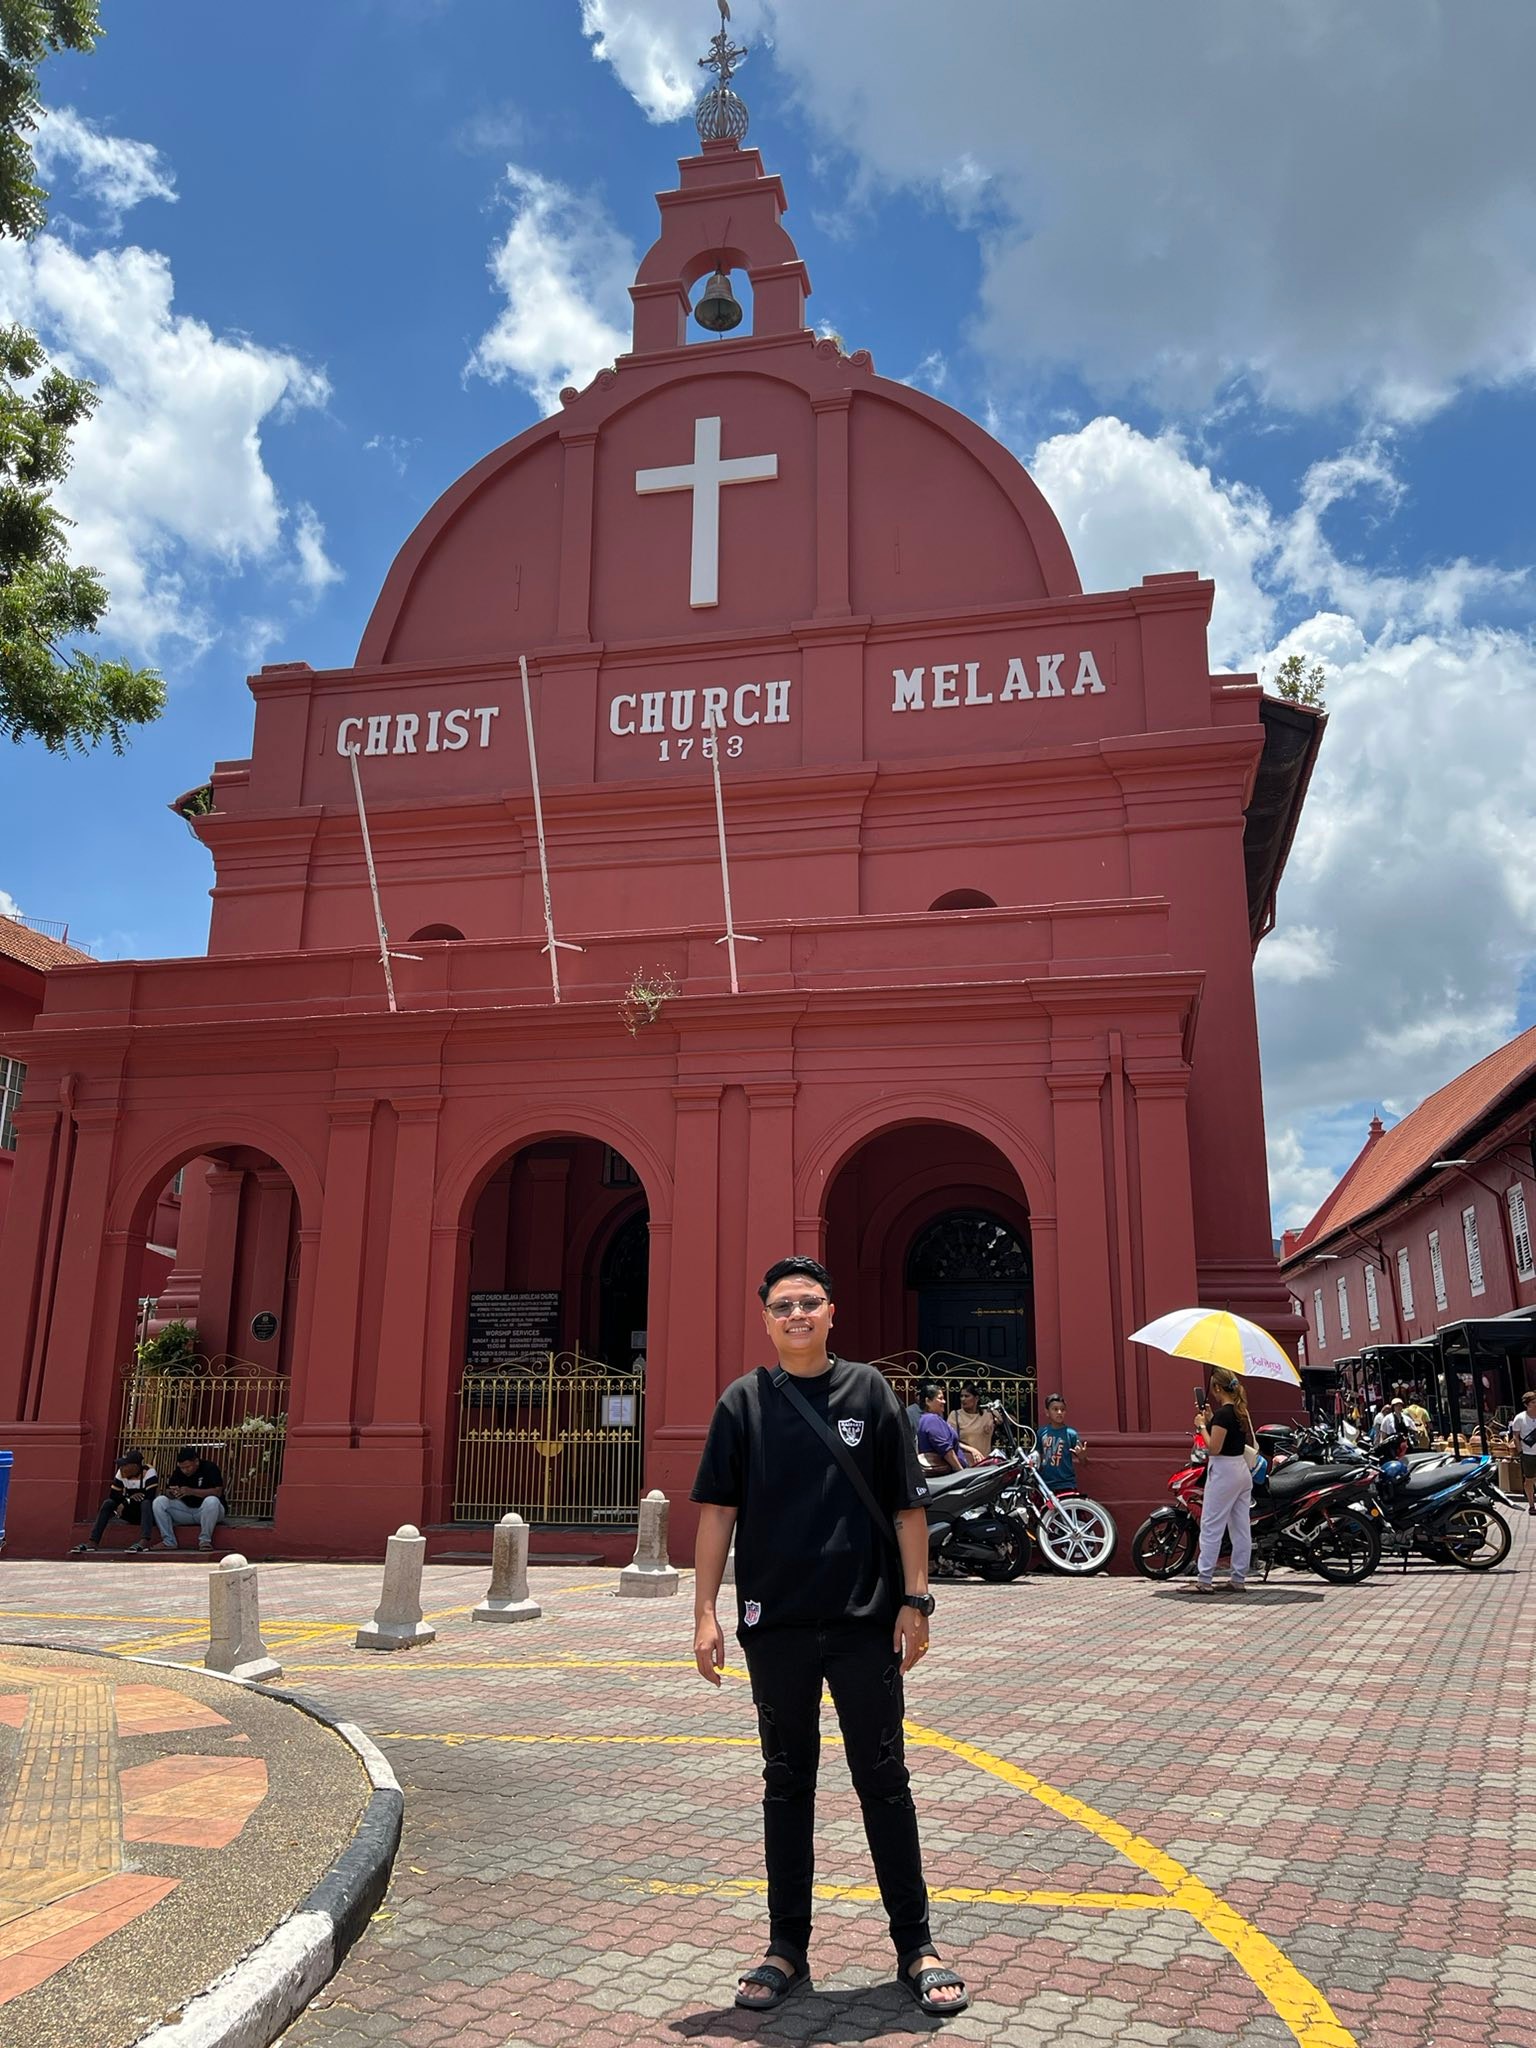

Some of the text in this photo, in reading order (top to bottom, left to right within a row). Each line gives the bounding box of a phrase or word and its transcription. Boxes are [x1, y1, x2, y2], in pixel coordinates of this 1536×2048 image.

[336, 650, 1106, 757] CHRIST CHURCH MELAKA
[658, 735, 743, 762] 1753
